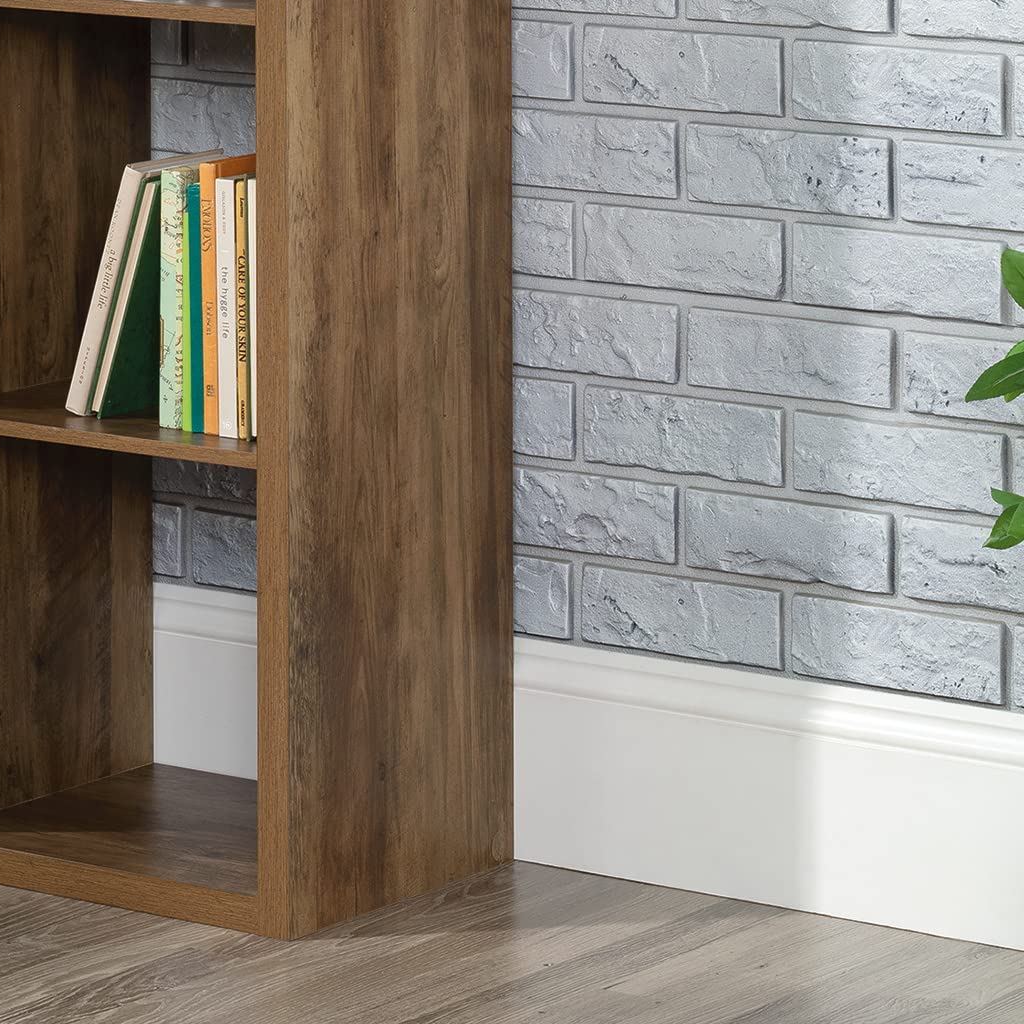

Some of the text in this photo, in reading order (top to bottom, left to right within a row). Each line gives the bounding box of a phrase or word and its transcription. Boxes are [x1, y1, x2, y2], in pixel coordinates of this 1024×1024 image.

[104, 256, 117, 271] big
[238, 255, 246, 284] CARE
[101, 271, 113, 293] little
[238, 286, 246, 301] OF
[97, 294, 108, 310] life
[219, 287, 228, 317] hygge
[238, 302, 246, 333] YOUR
[238, 335, 247, 362] SKIN
